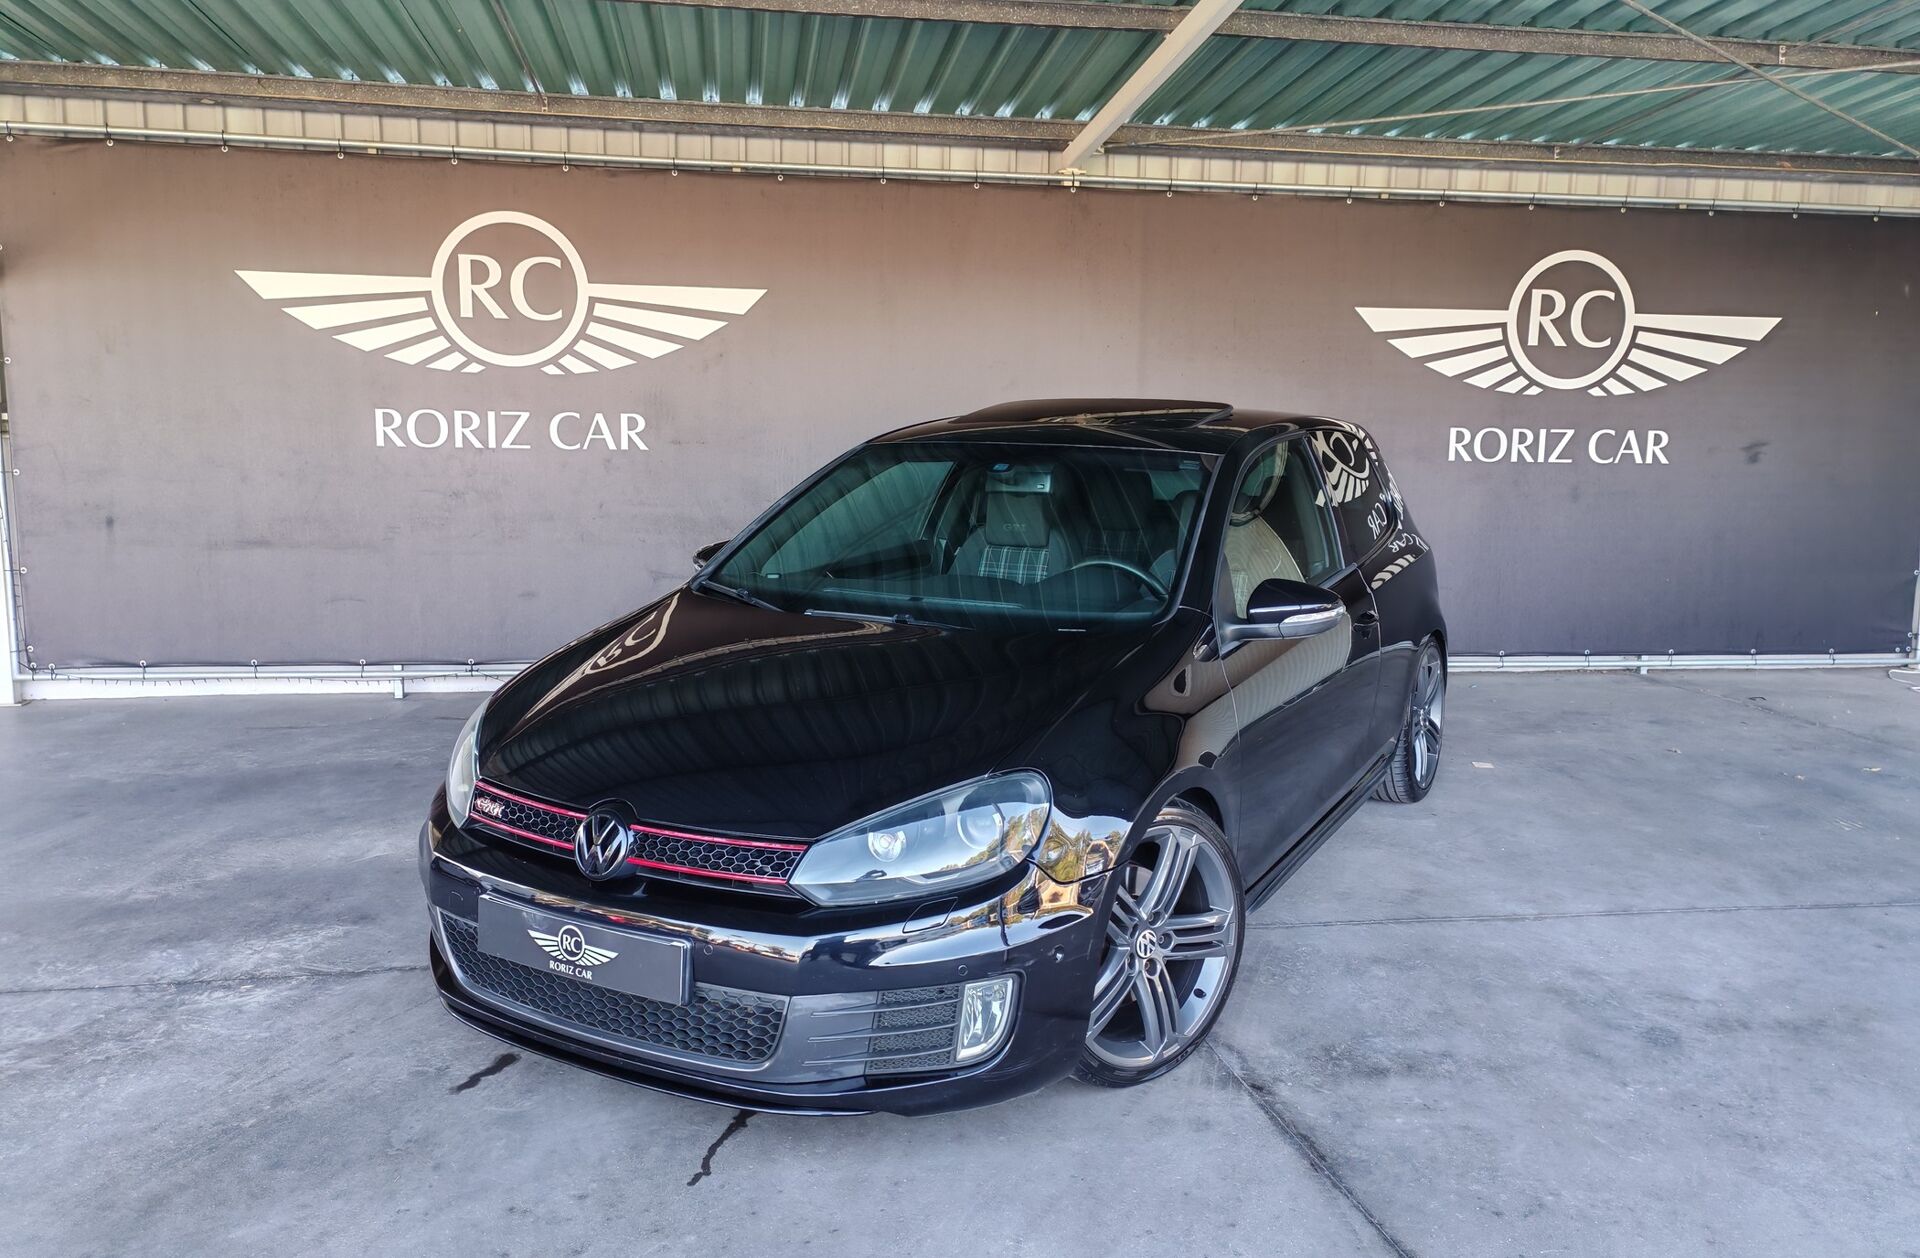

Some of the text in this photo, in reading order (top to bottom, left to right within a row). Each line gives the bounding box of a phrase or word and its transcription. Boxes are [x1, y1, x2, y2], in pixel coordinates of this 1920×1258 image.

[457, 253, 563, 322] RC
[1526, 288, 1616, 349] RC
[374, 407, 649, 451] RORIZ CAR
[1447, 427, 1670, 465] RORIZ CAR
[562, 934, 582, 954] RC
[549, 960, 593, 981] RORIZ CAR
